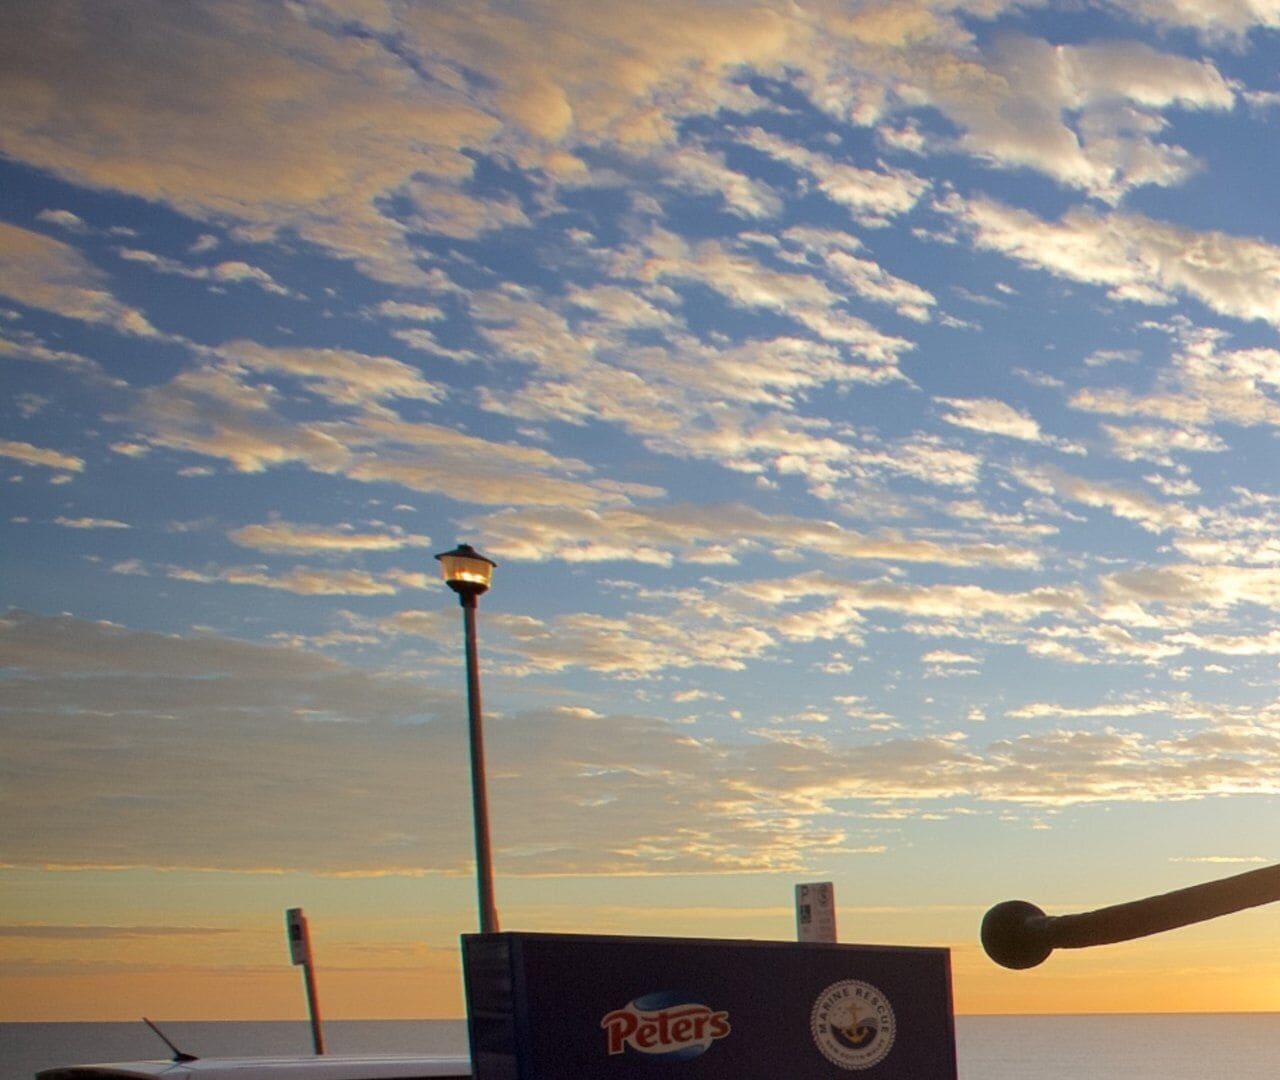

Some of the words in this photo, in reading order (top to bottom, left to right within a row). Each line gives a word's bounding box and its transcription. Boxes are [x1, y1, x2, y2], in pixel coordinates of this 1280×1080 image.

[602, 1006, 731, 1054] Peters
[818, 987, 850, 1034] MARINE
[855, 988, 889, 1034] RESCUE
